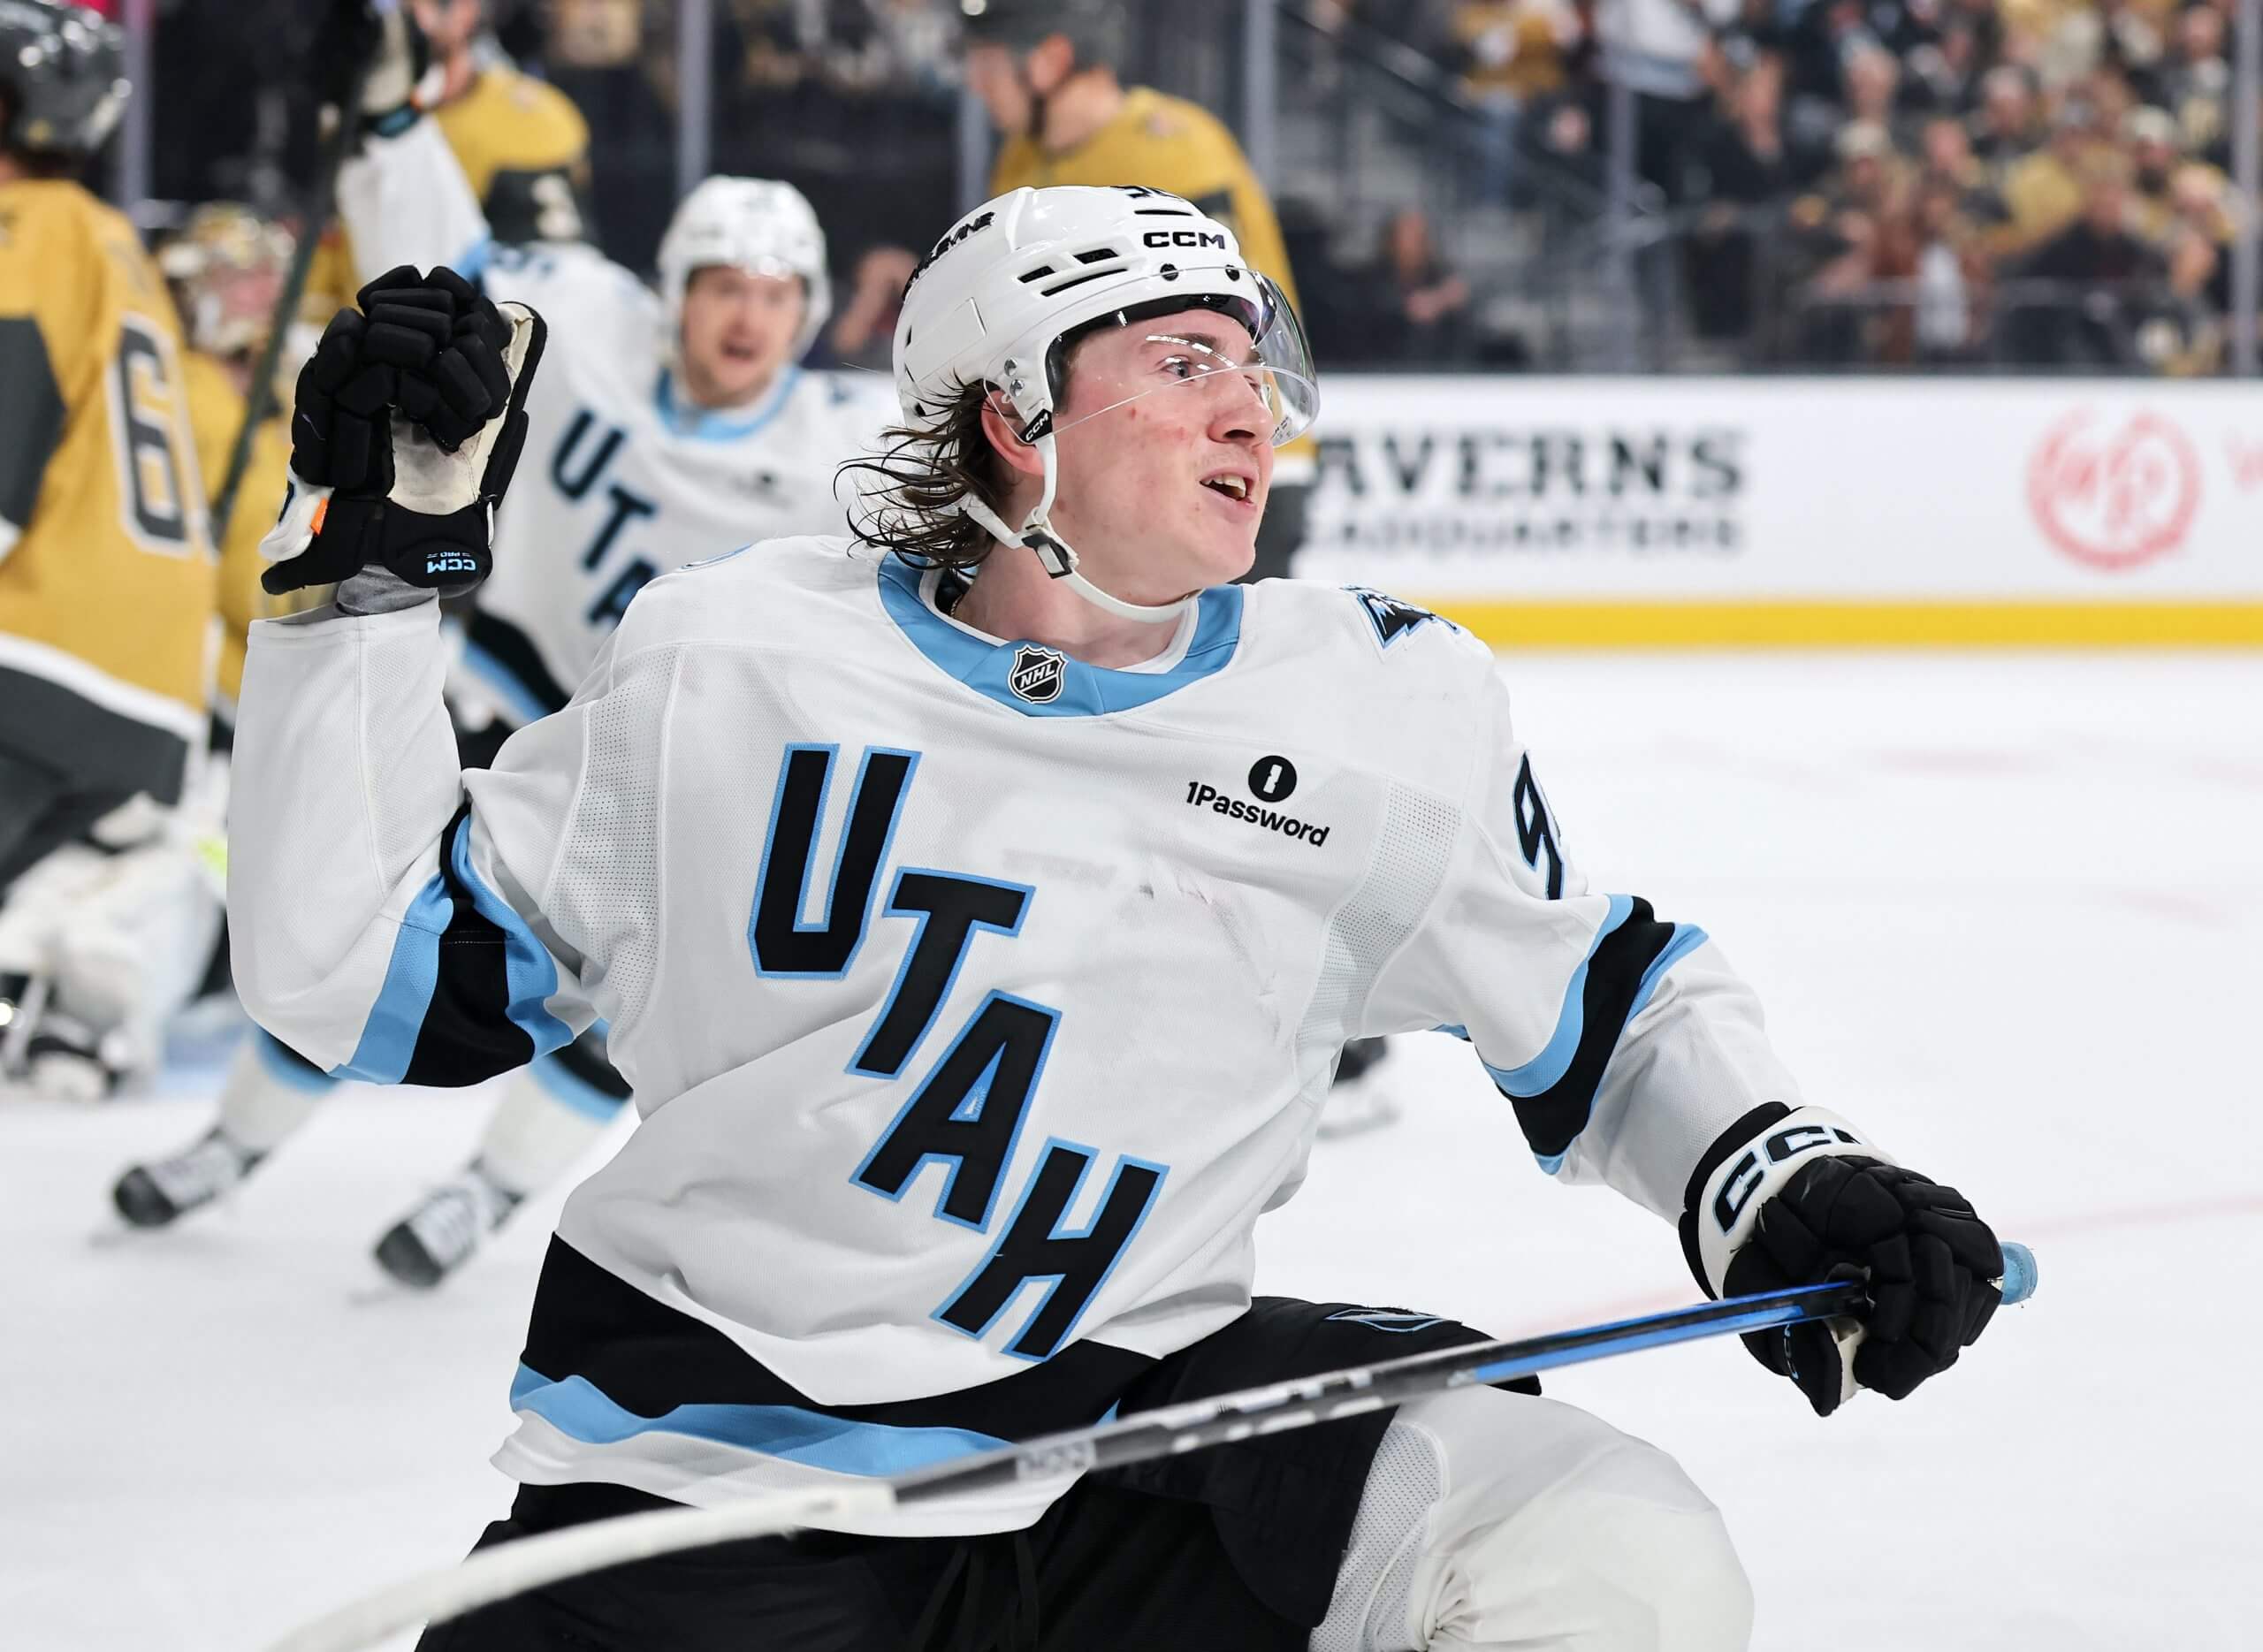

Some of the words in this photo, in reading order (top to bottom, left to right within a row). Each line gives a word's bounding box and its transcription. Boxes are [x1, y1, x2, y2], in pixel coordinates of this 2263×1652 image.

[1142, 231, 1226, 249] CCM
[1025, 412, 1049, 441] CCM
[426, 558, 476, 574] CCM
[1019, 663, 1055, 689] NHL
[1186, 780, 1330, 848] 1Password
[747, 742, 1170, 1363] UTAH
